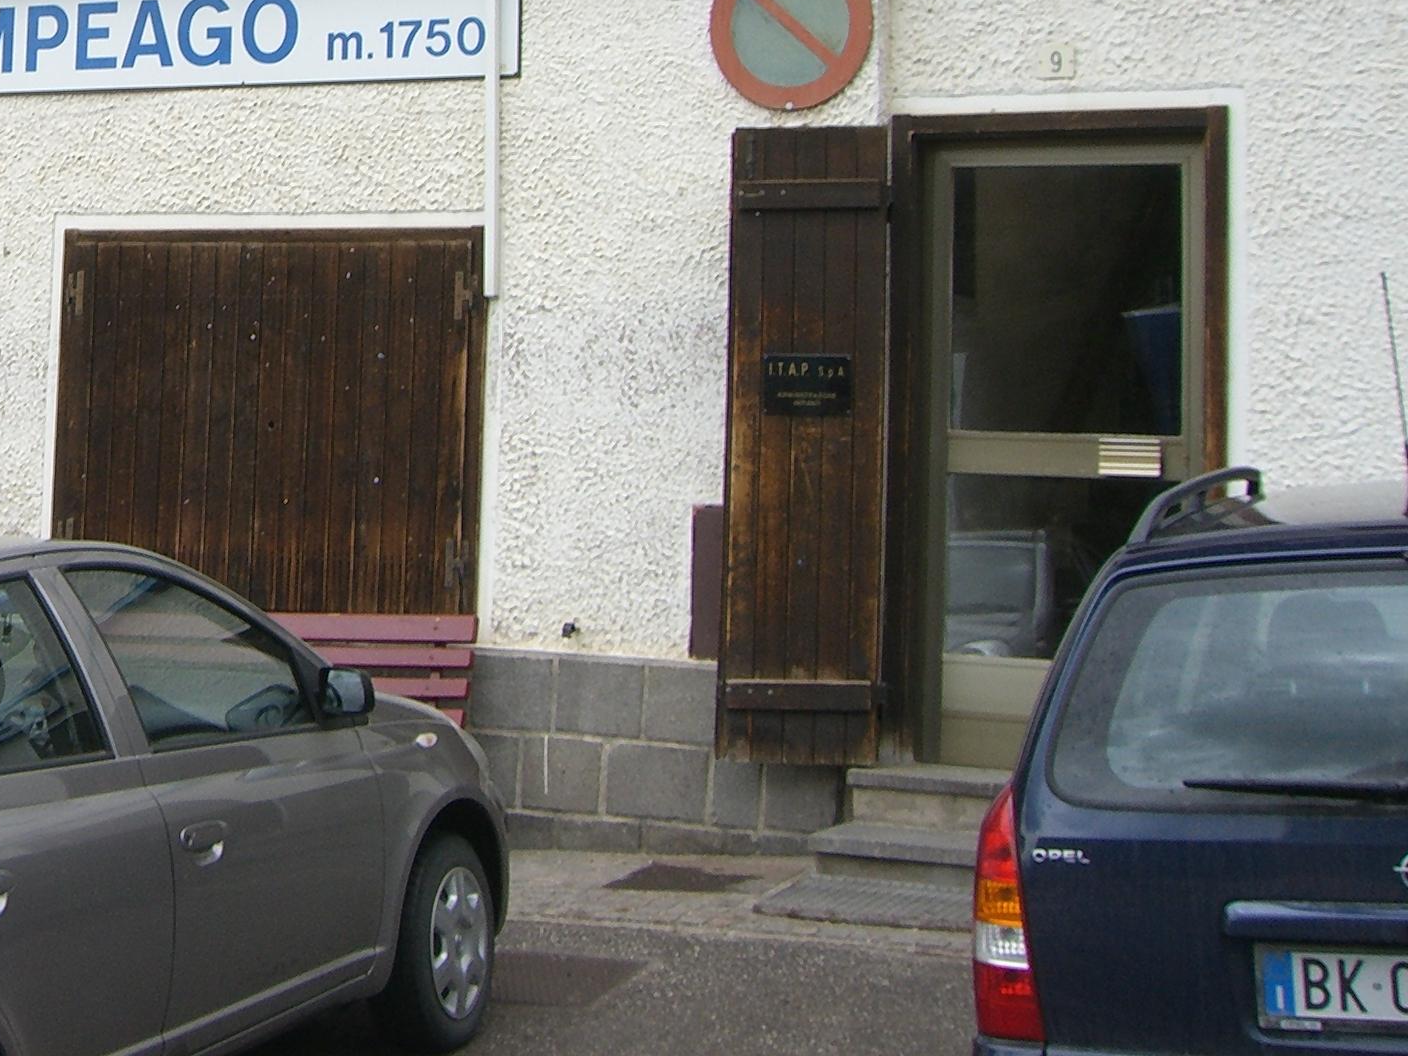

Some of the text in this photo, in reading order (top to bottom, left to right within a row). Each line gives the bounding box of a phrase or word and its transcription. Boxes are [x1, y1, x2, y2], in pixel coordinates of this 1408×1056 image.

[326, 16, 487, 62] m.1750
[1050, 50, 1062, 73] 9
[1032, 848, 1091, 865] OPEL
[1300, 957, 1368, 1013] BK
